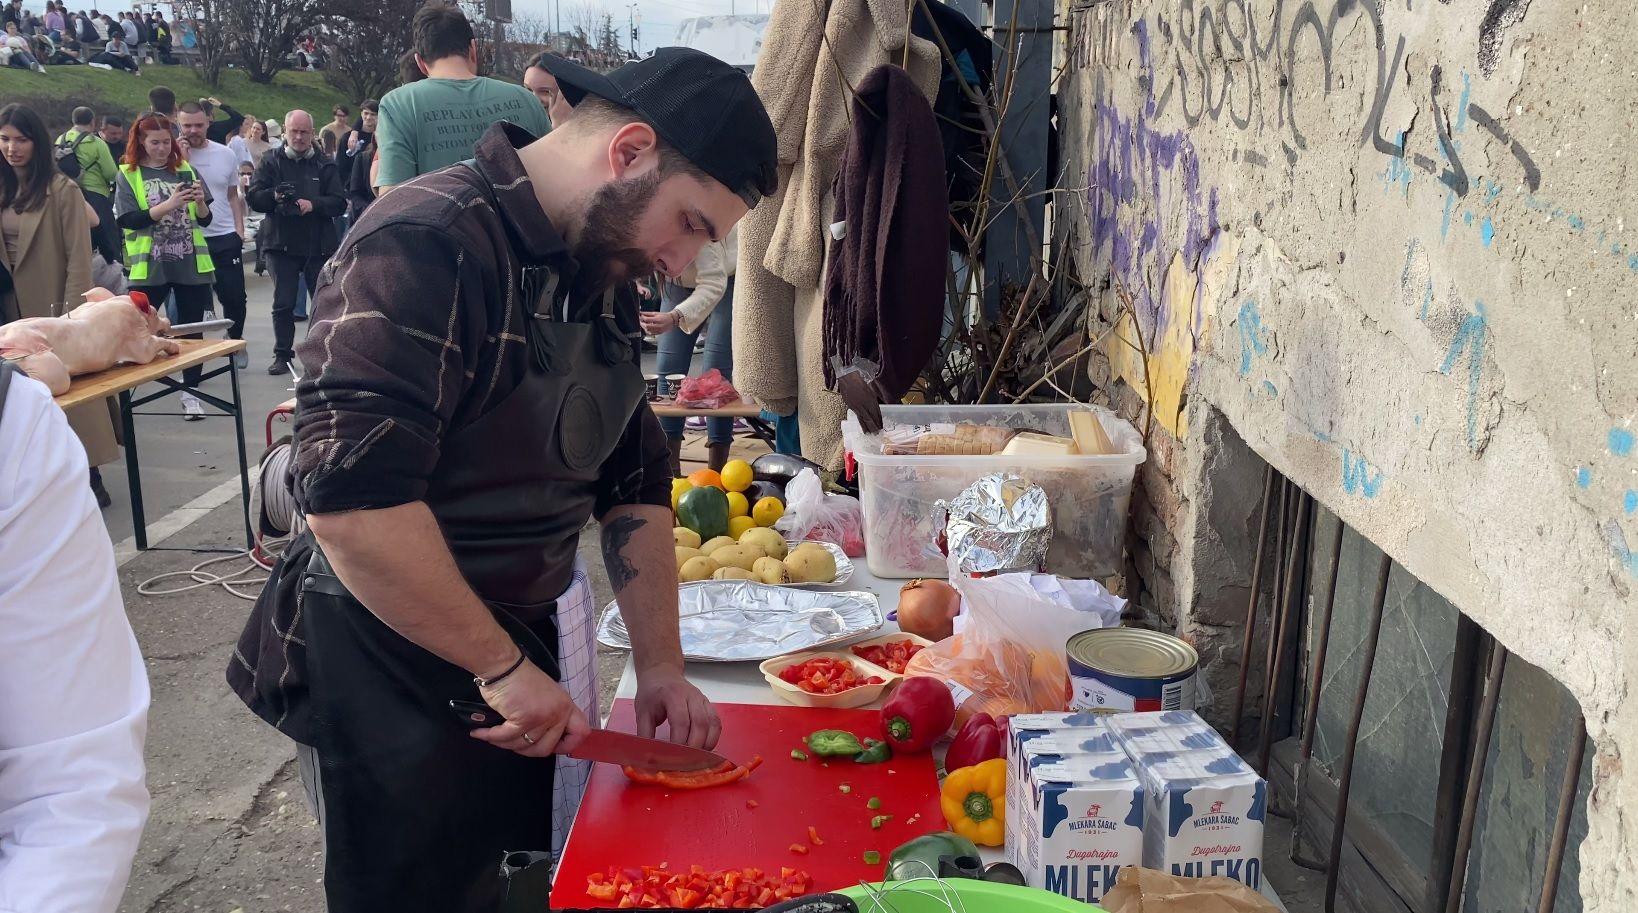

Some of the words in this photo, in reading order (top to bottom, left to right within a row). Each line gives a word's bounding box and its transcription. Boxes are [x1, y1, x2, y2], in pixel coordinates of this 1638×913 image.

[423, 109, 473, 123] REPLAY
[476, 99, 523, 118] GARAGE
[436, 124, 468, 135] BUILT
[423, 138, 468, 152] CUSTOM
[1068, 819, 1096, 831] MLEKARA
[1193, 816, 1219, 828] MLEKARA
[1066, 848, 1119, 861] Dugotrajno
[1191, 844, 1241, 857] Dugotrajno
[1045, 864, 1134, 904] MLEK
